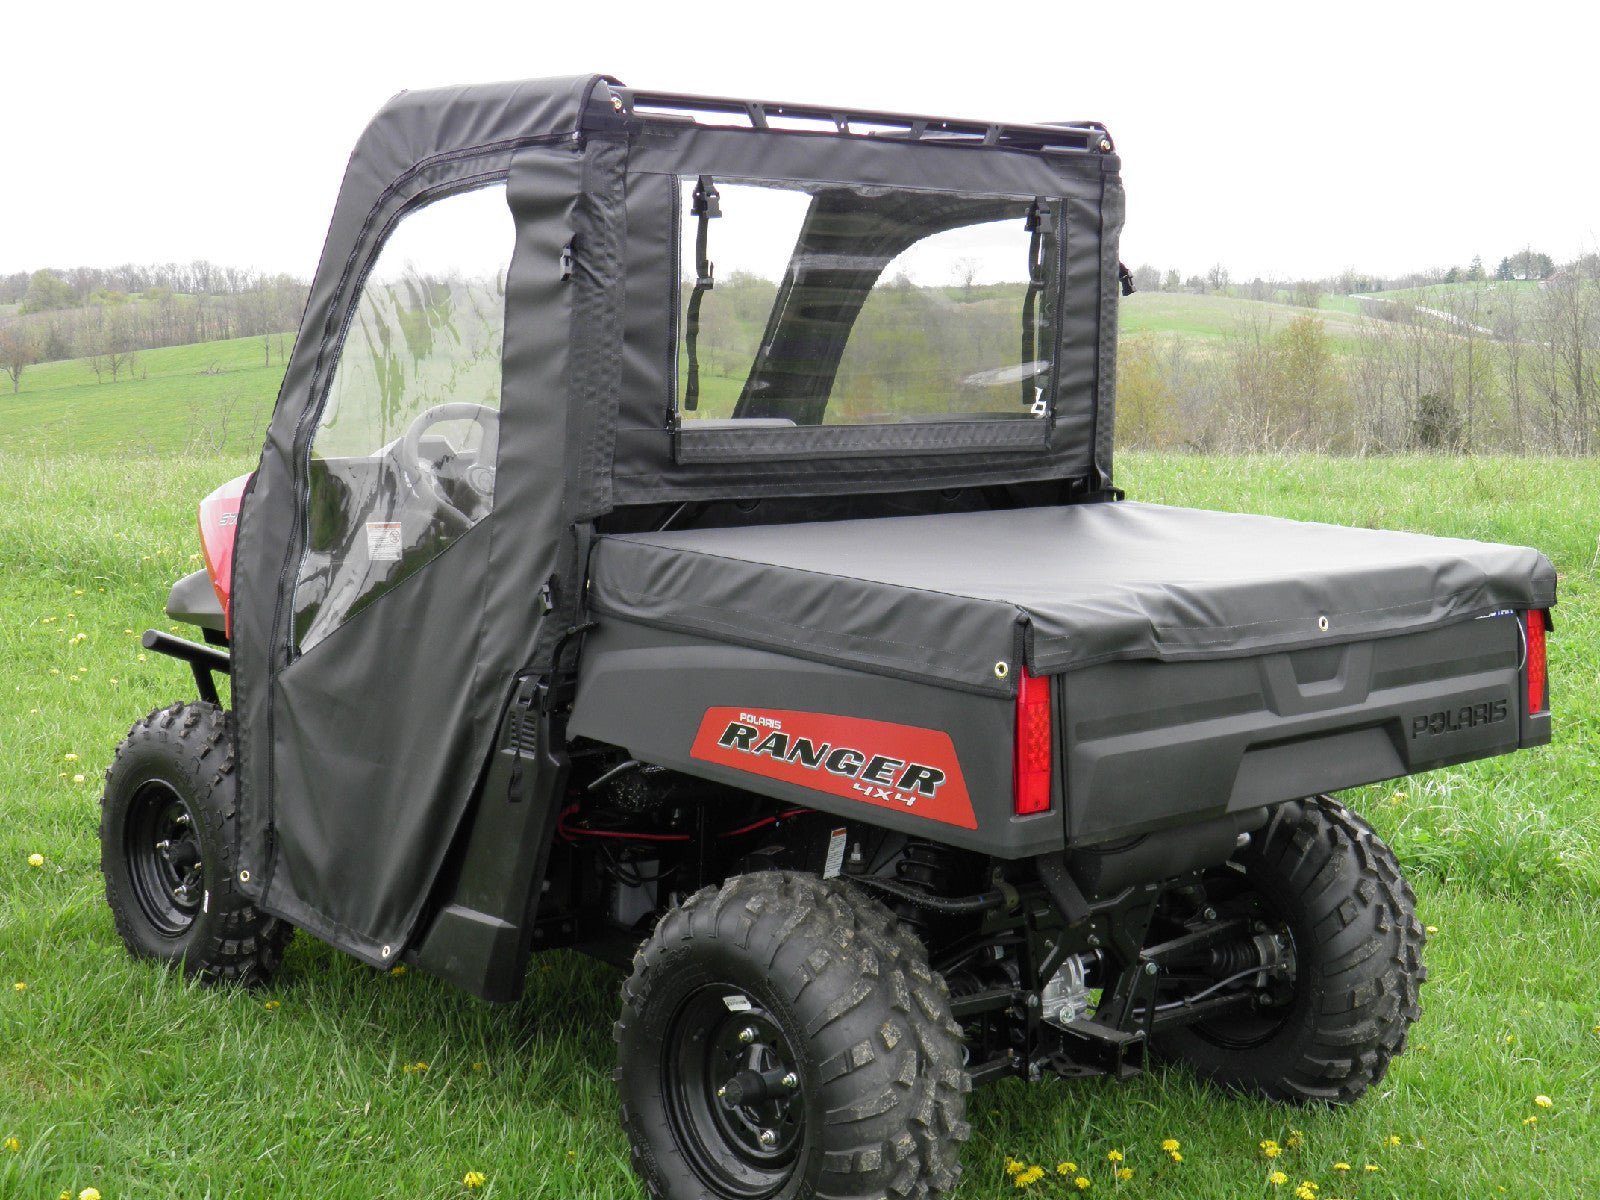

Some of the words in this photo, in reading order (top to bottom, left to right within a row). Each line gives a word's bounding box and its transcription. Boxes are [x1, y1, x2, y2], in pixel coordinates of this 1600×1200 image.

[739, 712, 782, 730] POLARIS
[1412, 699, 1507, 740] POLARIS
[717, 721, 947, 798] RANGER
